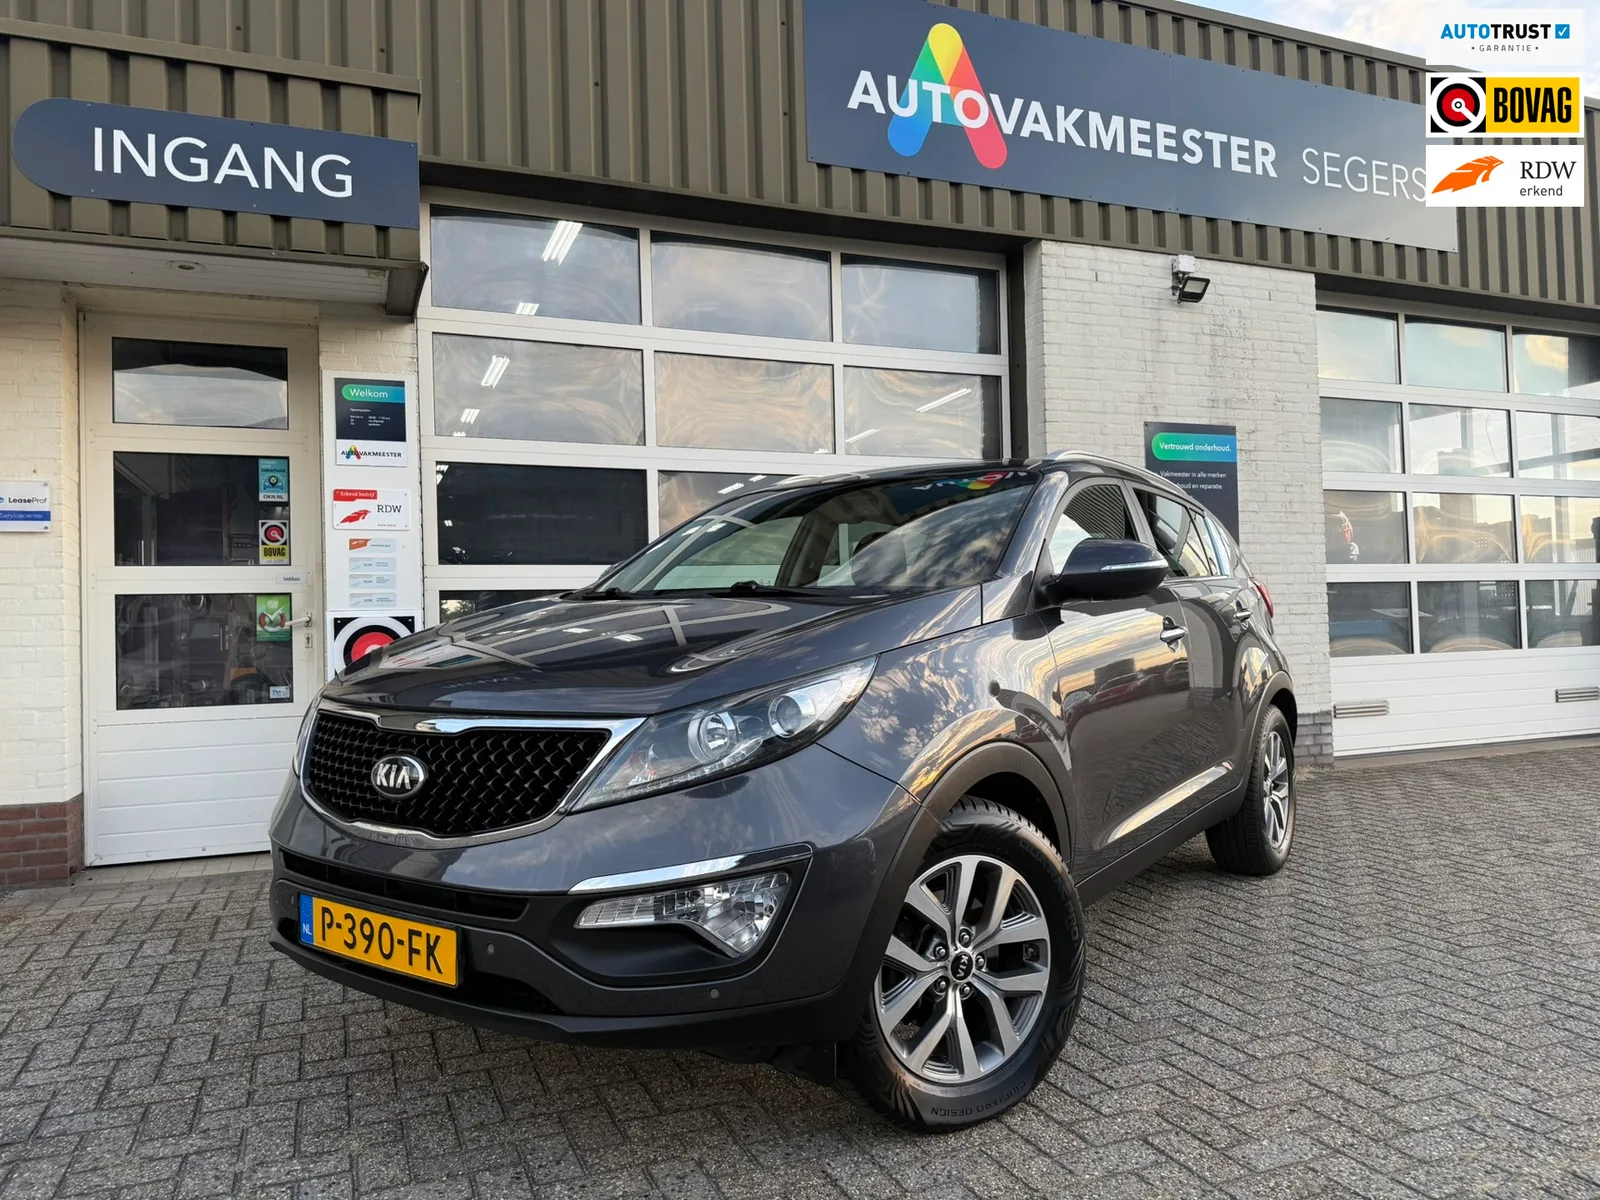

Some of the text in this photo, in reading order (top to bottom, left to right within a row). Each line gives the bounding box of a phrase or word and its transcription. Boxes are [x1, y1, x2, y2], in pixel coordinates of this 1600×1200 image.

[847, 70, 1426, 202] AUTOVAKMEESTER SEGERS
[94, 127, 353, 198] INGANG
[349, 388, 388, 399] Welkom
[1159, 442, 1194, 450] Vertrouwd
[341, 450, 402, 458] AUTOVAKMEESTER
[1159, 470, 1191, 478] Vakmeester
[1207, 471, 1227, 479] merken
[8, 496, 47, 504] LeaseProf
[377, 504, 402, 513] RDW
[263, 547, 286, 557] BOVAG
[375, 763, 412, 790] KIA
[302, 923, 312, 935] NL
[321, 906, 443, 975] P-390-FK
[956, 955, 969, 977] KIA
[930, 1107, 973, 1117] DESIGN
